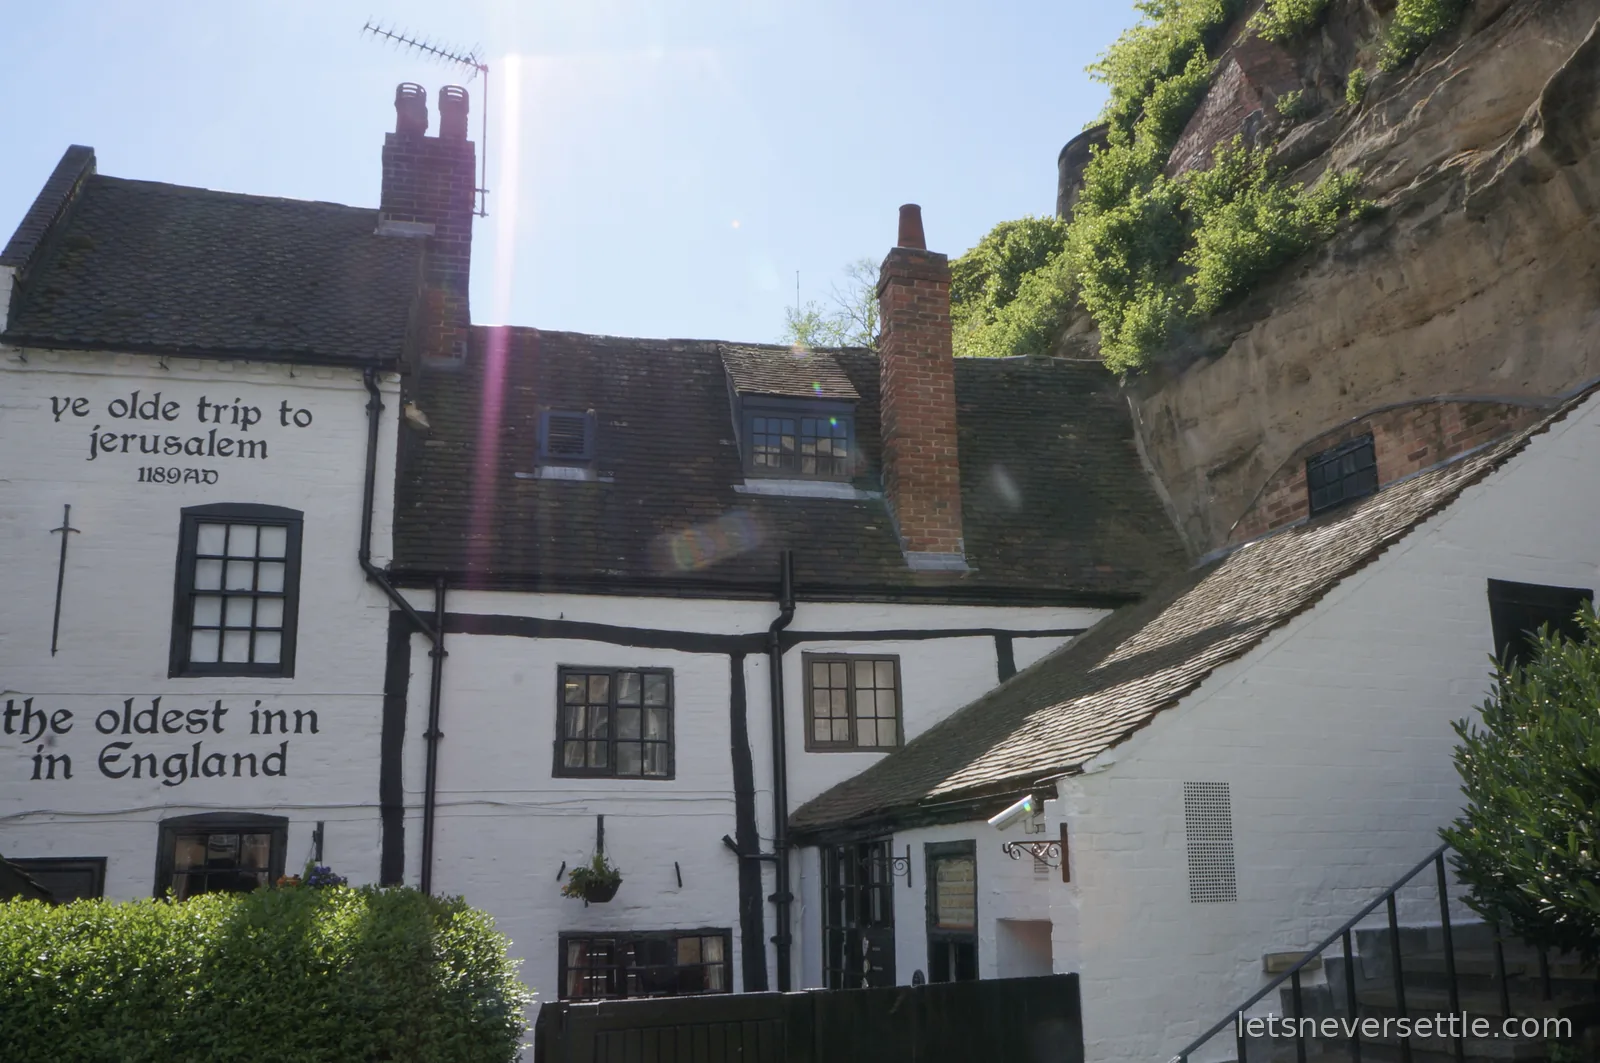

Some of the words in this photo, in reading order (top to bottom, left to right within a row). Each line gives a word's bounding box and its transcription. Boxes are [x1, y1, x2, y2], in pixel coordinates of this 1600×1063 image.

[50, 396, 90, 422] ye
[107, 390, 181, 421] olde
[197, 397, 262, 431] trip
[279, 400, 313, 428] to
[86, 424, 268, 461] jerusalem
[137, 466, 219, 485] 1189AD
[3, 697, 74, 744] the
[95, 696, 229, 734] oldest
[250, 700, 320, 735] inn
[30, 744, 73, 780] in
[98, 740, 289, 787] England
